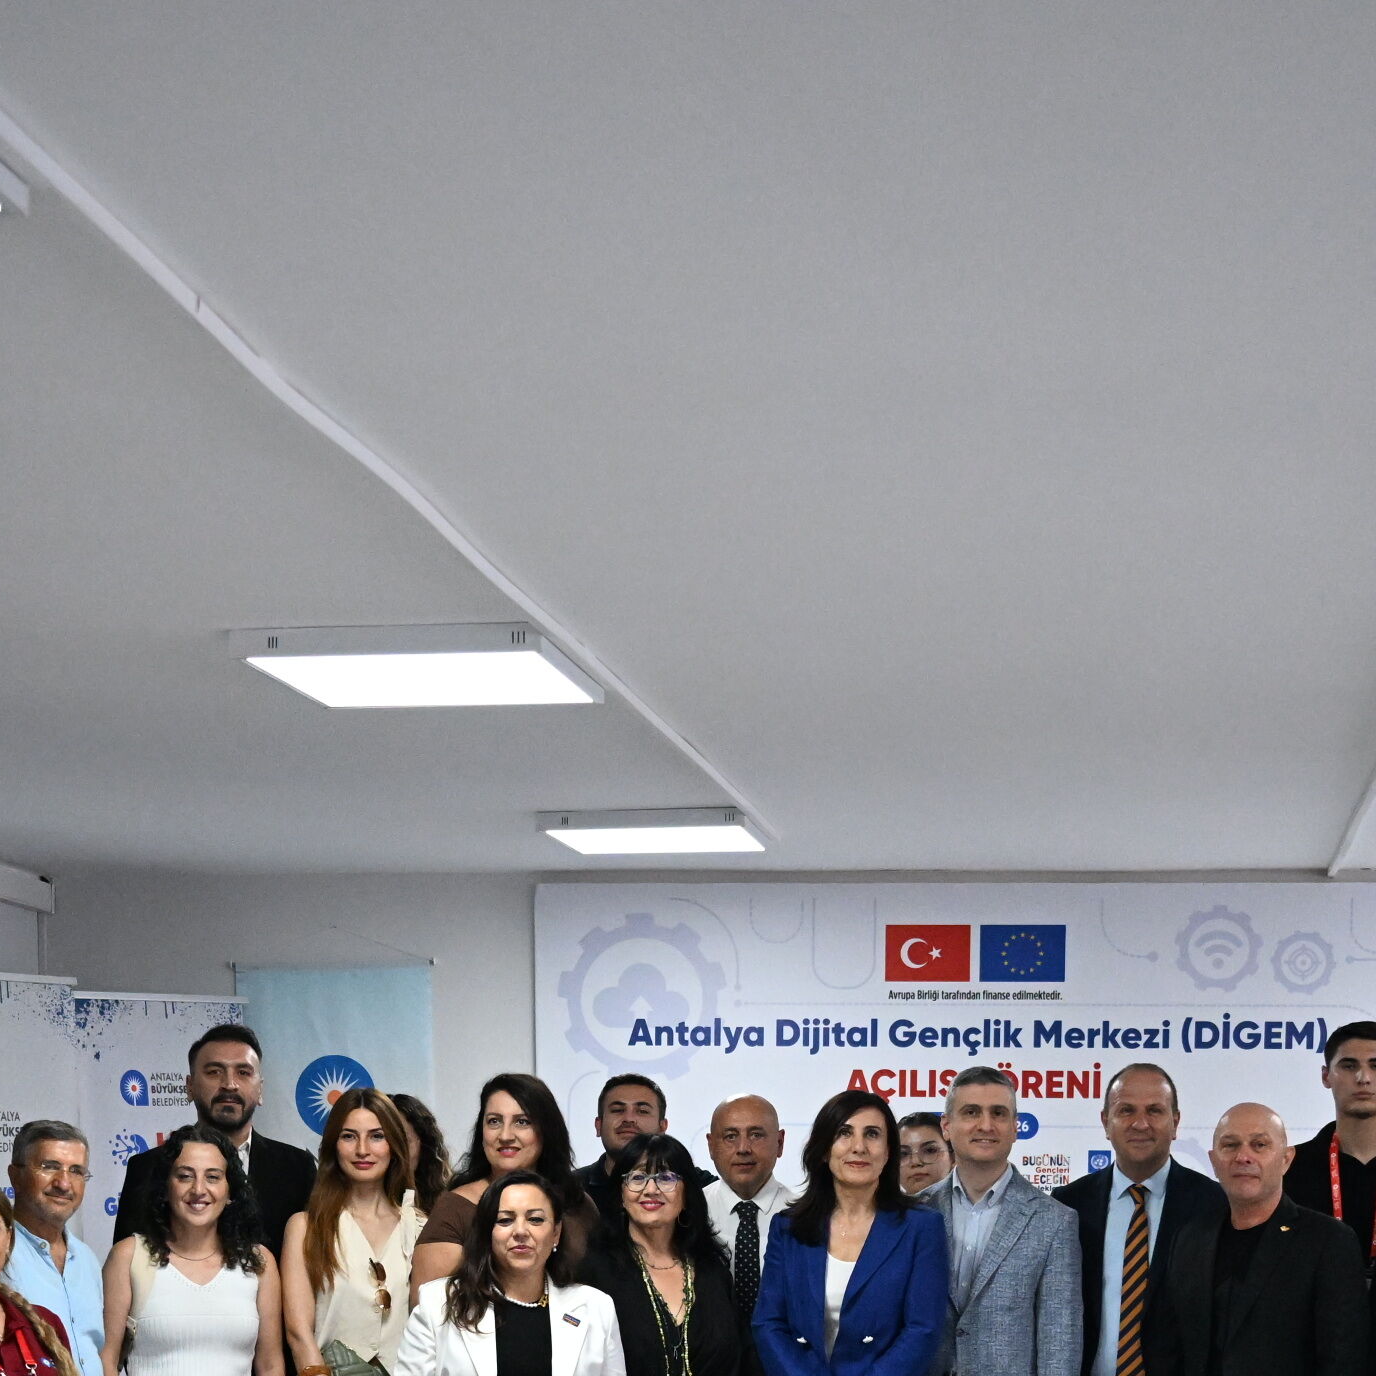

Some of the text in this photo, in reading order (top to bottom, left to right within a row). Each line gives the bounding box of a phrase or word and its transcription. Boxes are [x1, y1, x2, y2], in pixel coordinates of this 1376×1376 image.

[888, 989, 1063, 1002] Avrupa Birliği tarafından finanse edilmektedir.
[628, 1012, 1328, 1056] Antalya Dijital Gençlik Merkezi (DİGEM)
[150, 1073, 184, 1082] ANTALYA
[151, 1083, 187, 1096] BÜYÜKŞE
